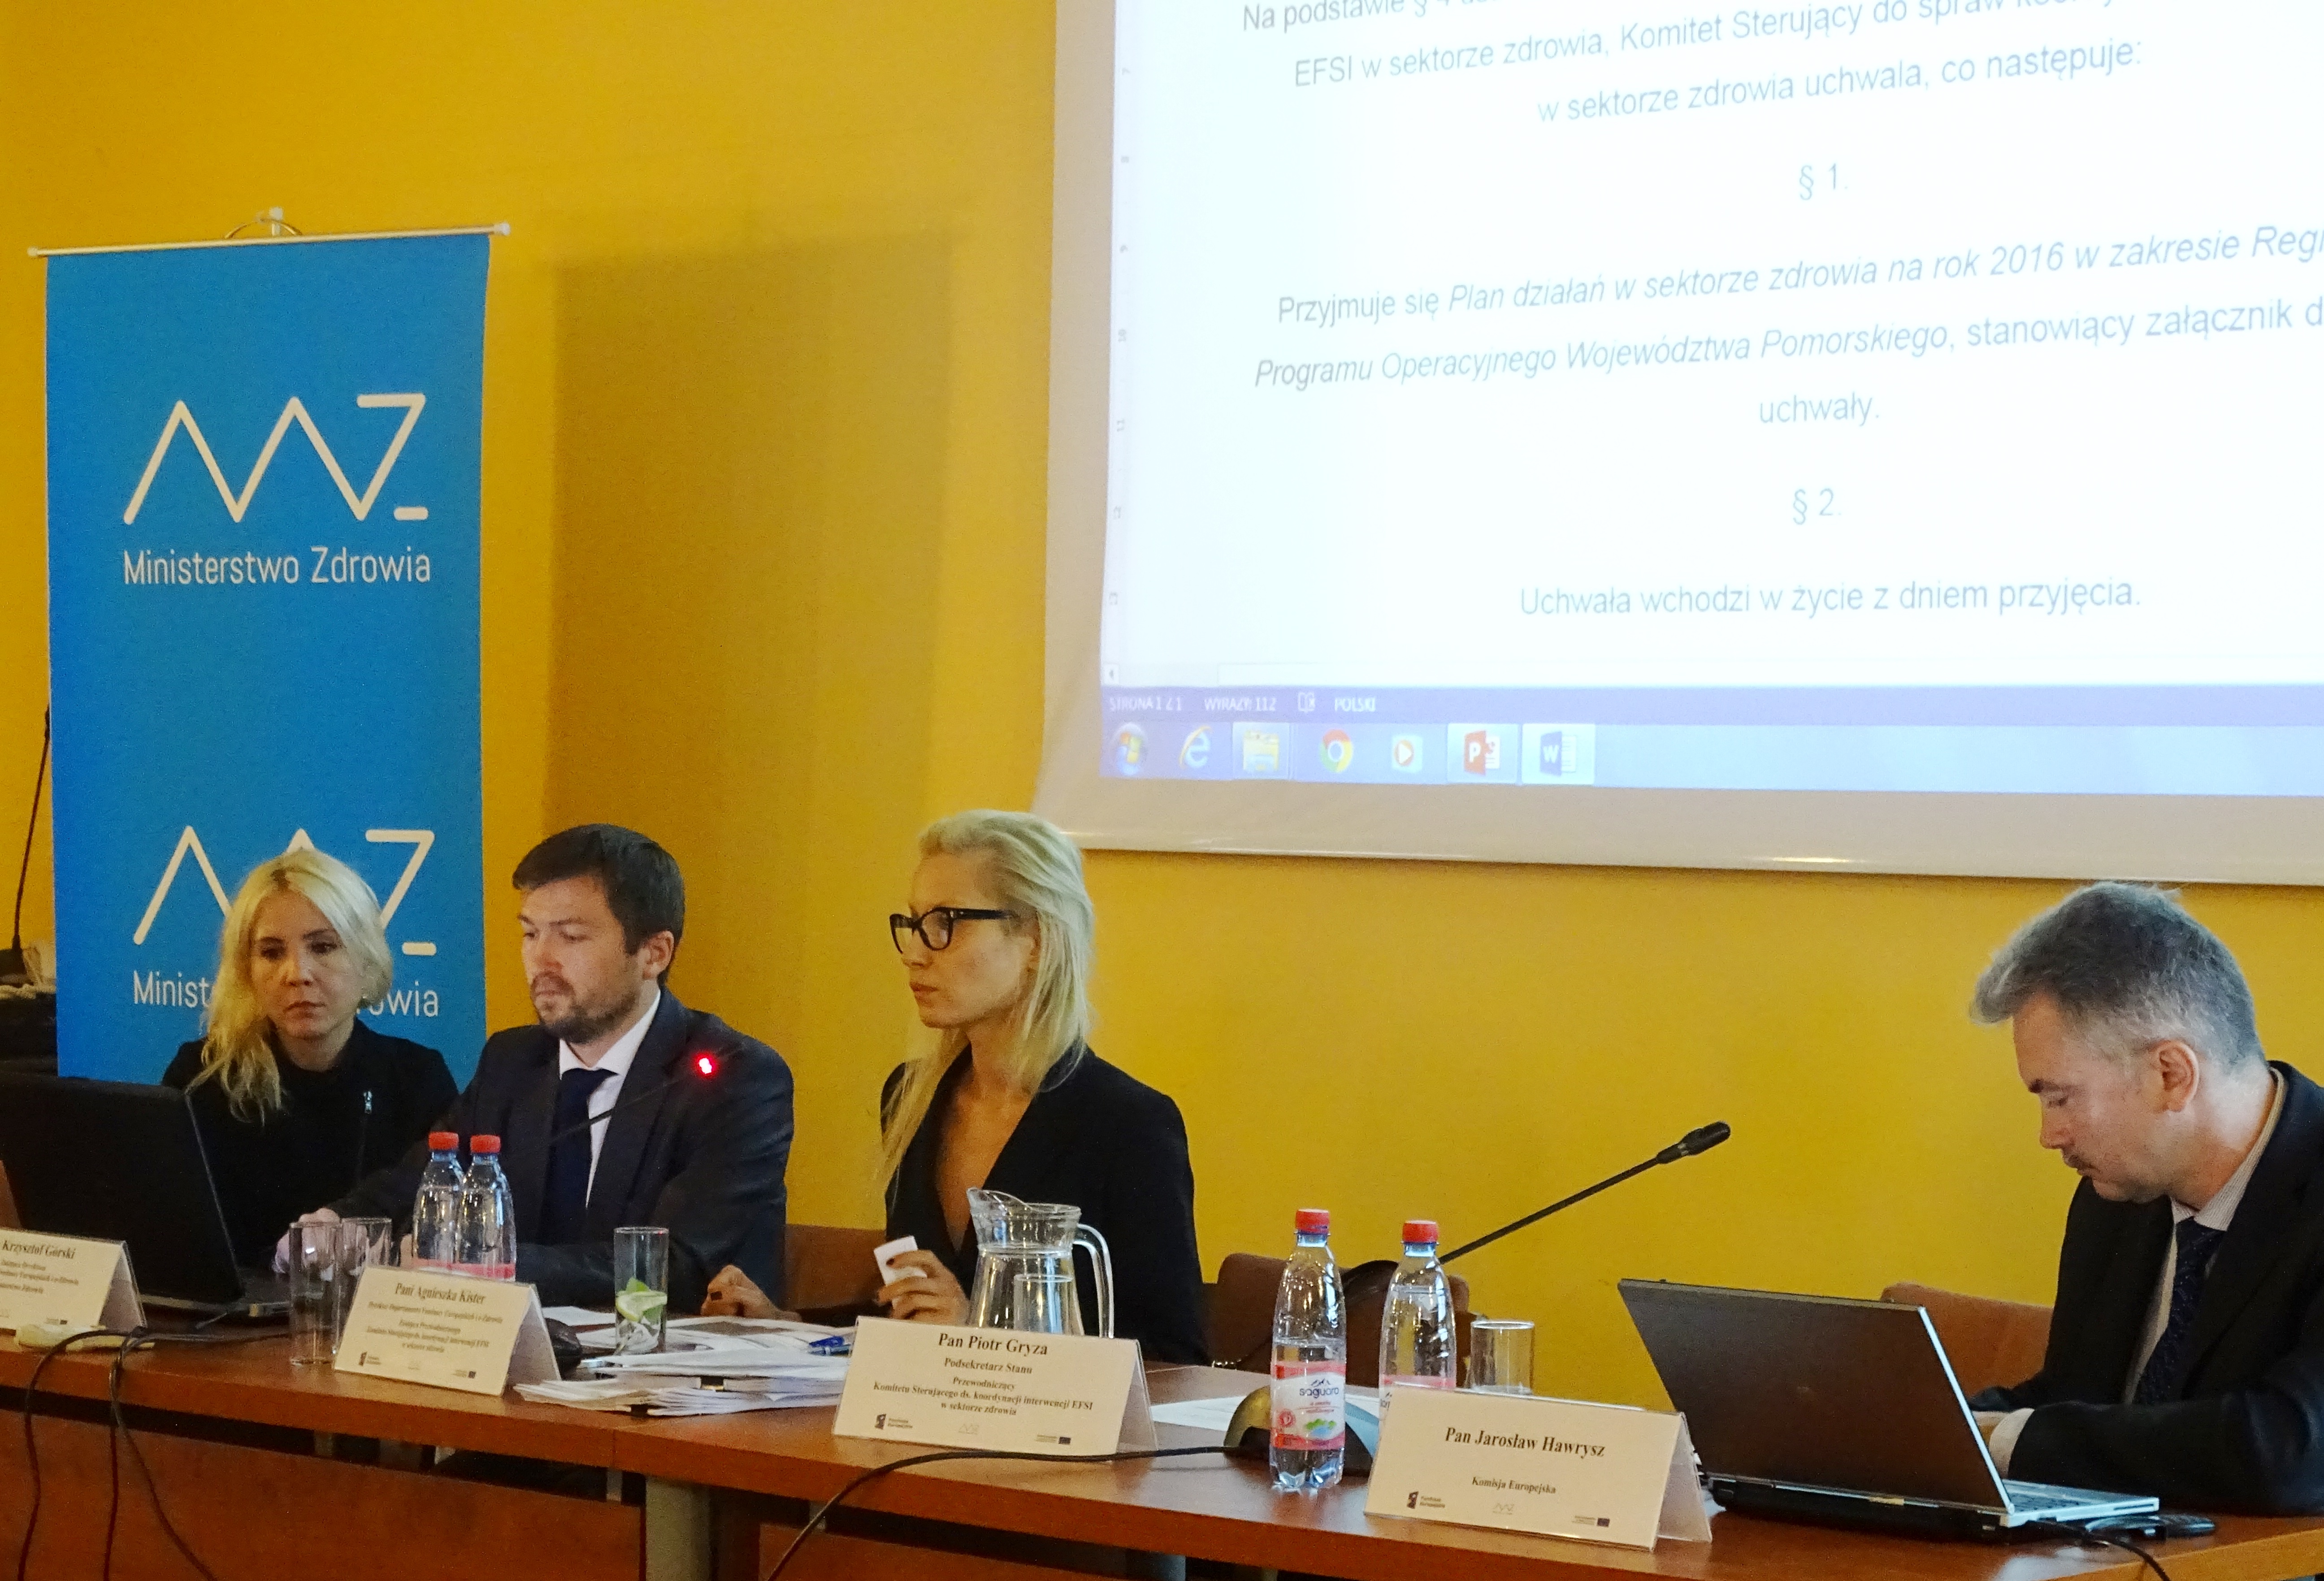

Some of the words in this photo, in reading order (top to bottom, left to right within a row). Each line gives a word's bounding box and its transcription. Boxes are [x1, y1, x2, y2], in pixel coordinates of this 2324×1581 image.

[1244, 4, 1275, 31] Na
[1295, 56, 1353, 86] EFSI
[1362, 57, 1382, 78] w
[1389, 46, 1494, 76] sektorze
[1503, 29, 1609, 64] zdrowia,
[1621, 14, 1722, 51] Komitet
[1732, 4, 1863, 39] Sterujący
[1873, 0, 1908, 23] do
[1538, 101, 1559, 121] w
[1568, 89, 1678, 121] sektorze
[1688, 72, 1794, 108] zdrowia
[1805, 60, 1929, 97] uchwala,
[1942, 59, 1973, 84] co
[1986, 37, 2143, 80] następuje:
[1828, 163, 1850, 191] 1.
[1279, 290, 1395, 329] Przyjmuje
[1404, 288, 1439, 321] się
[1448, 282, 1505, 312] Plan
[1513, 273, 1605, 308] działań
[1615, 278, 1636, 301] w
[1644, 268, 1759, 299] sektorze
[1768, 256, 1877, 291] zdrowia
[1887, 258, 1923, 282] na
[1933, 248, 1981, 279] rok
[1990, 241, 2064, 276] 2016
[2075, 244, 2100, 269] w
[2108, 229, 2240, 268] zakresie
[1254, 359, 1373, 391] Programu
[1382, 346, 1557, 386] Operacyjnego
[1566, 334, 1750, 375] Województwa
[1760, 322, 1955, 359] Pomorskiego,
[1967, 310, 2135, 347] stanowiący
[2146, 298, 2294, 340] załącznik
[1759, 391, 1881, 427] uchwały.
[1819, 488, 1843, 516] 2.
[123, 549, 299, 585] Ministerstwo
[310, 545, 431, 584] Zdrowia
[1520, 584, 1632, 615] Uchwała
[1640, 583, 1751, 613] wchodzi
[1760, 588, 1783, 610] w
[1791, 580, 1864, 619] życie
[1873, 585, 1889, 610] z
[1899, 578, 1987, 610] dniem
[1998, 576, 2142, 618] przyjęcia.
[1256, 697, 1277, 711] 112
[1335, 697, 1376, 712] POLSKI
[134, 970, 212, 1008] Minist
[938, 1333, 963, 1348] Pan
[968, 1335, 1002, 1351] Piotr
[1006, 1338, 1048, 1357] Gryza
[944, 1357, 1003, 1372] Podsekretarz
[1006, 1363, 1033, 1374] Stanu
[1299, 1387, 1339, 1399] saguaro
[984, 1405, 1016, 1416] zdrowia
[1444, 1426, 1471, 1443] Pan
[1474, 1430, 1538, 1450] Jarosław
[1542, 1436, 1605, 1460] Hawrysz
[1472, 1476, 1506, 1490] Komisja
[1509, 1480, 1557, 1494] Europejska
